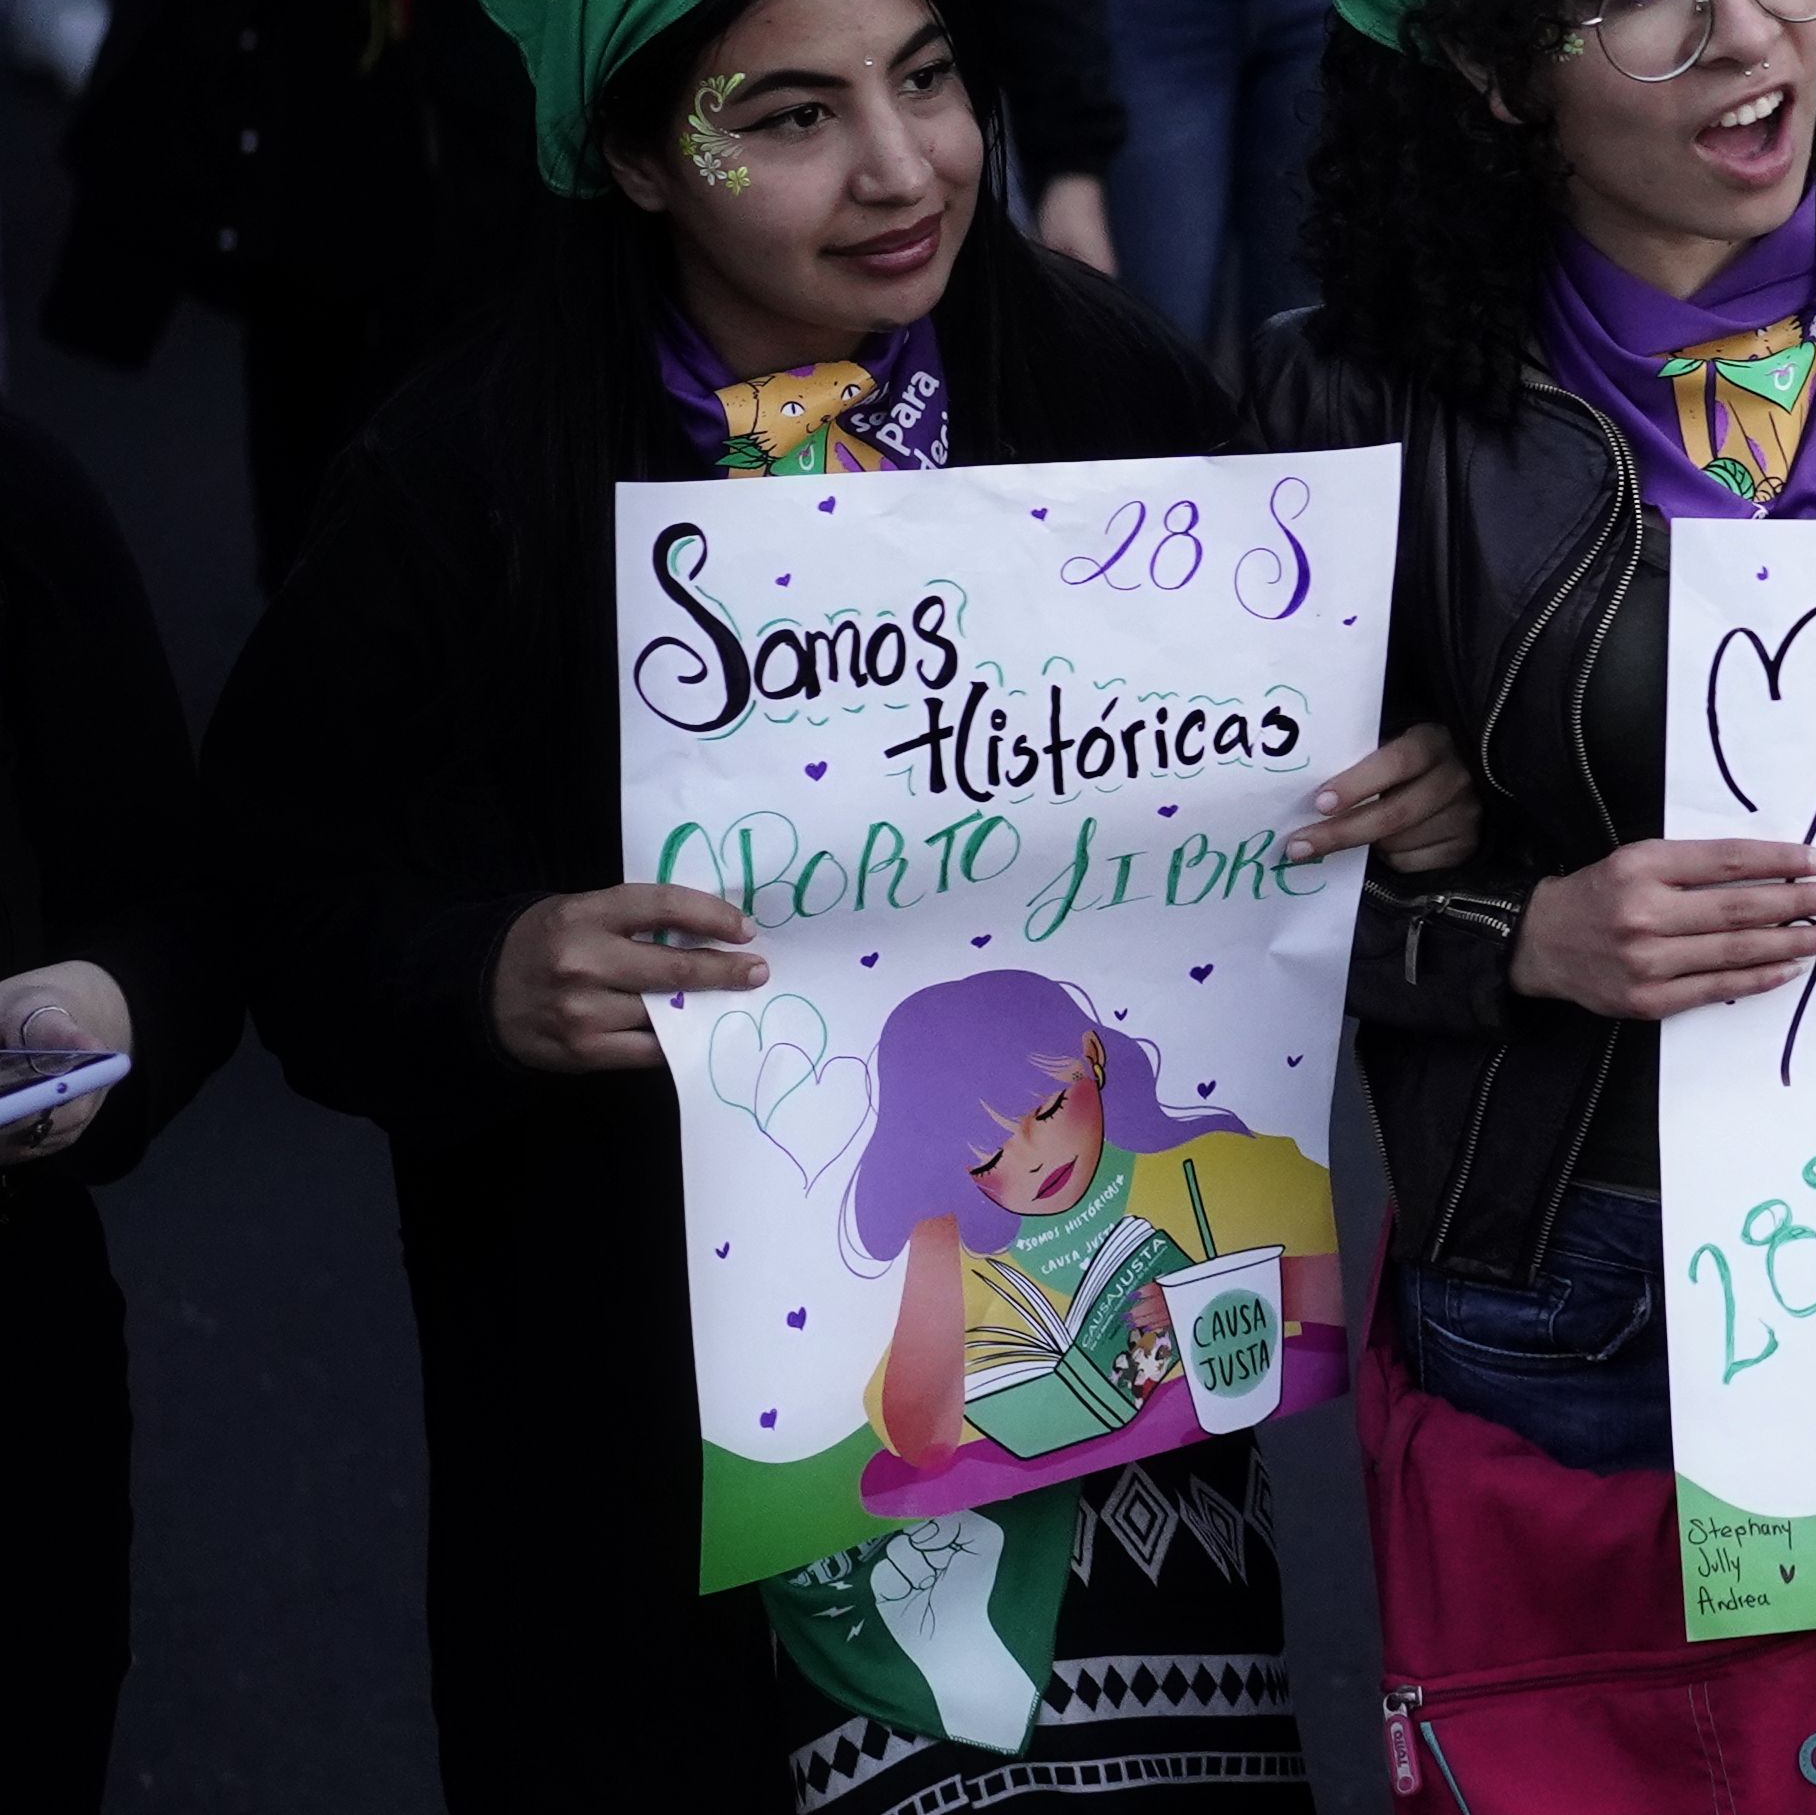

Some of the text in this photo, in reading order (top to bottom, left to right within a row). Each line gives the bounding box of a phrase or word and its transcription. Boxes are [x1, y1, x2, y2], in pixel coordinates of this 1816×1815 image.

[876, 370, 940, 457] para
[1060, 476, 1312, 620] 28 S
[634, 522, 958, 733] Somos
[884, 680, 1301, 804] Históricas
[1041, 1249, 1081, 1275] CAUSA
[1193, 1297, 1267, 1348] CAUSA
[1199, 1338, 1271, 1392] JUSTA
[1688, 1518, 1793, 1550] Stephany
[1697, 1588, 1771, 1615] Andrea
